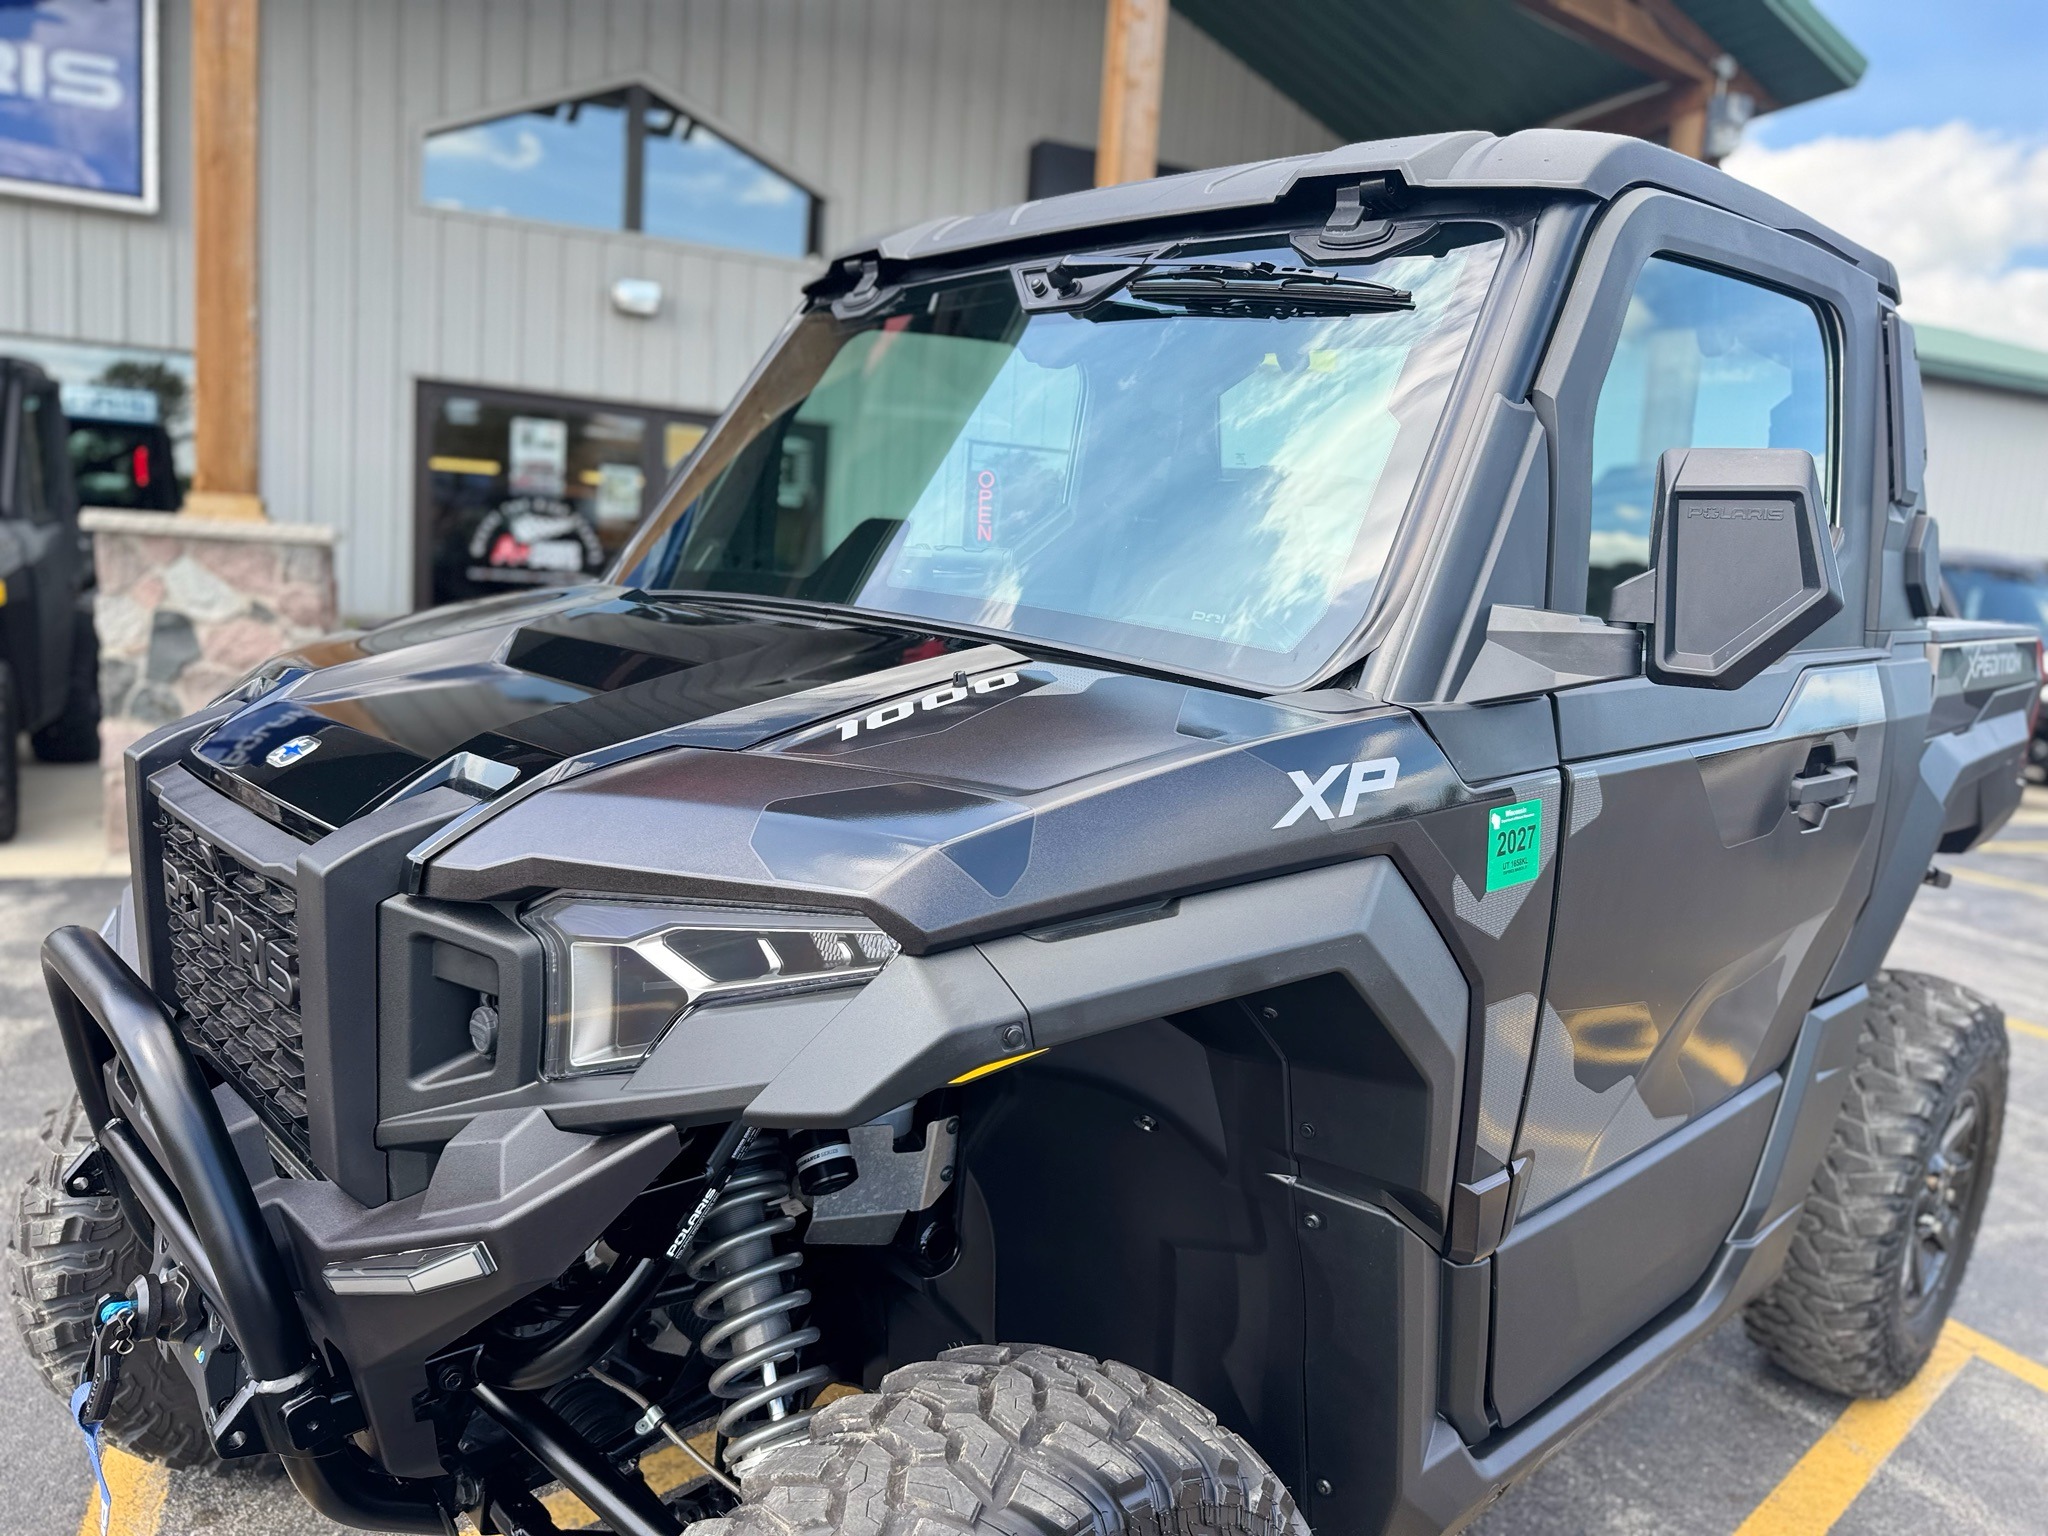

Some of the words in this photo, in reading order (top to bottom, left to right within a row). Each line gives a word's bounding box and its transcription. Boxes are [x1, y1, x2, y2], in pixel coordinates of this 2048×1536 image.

[977, 469, 995, 541] OPEN
[1687, 506, 1785, 521] POLARIS
[836, 673, 1020, 741] 1000
[1271, 756, 1400, 830] XP
[1497, 825, 1536, 857] 2027
[163, 858, 293, 1006] POLARIS
[666, 1188, 716, 1257] POLARIS
